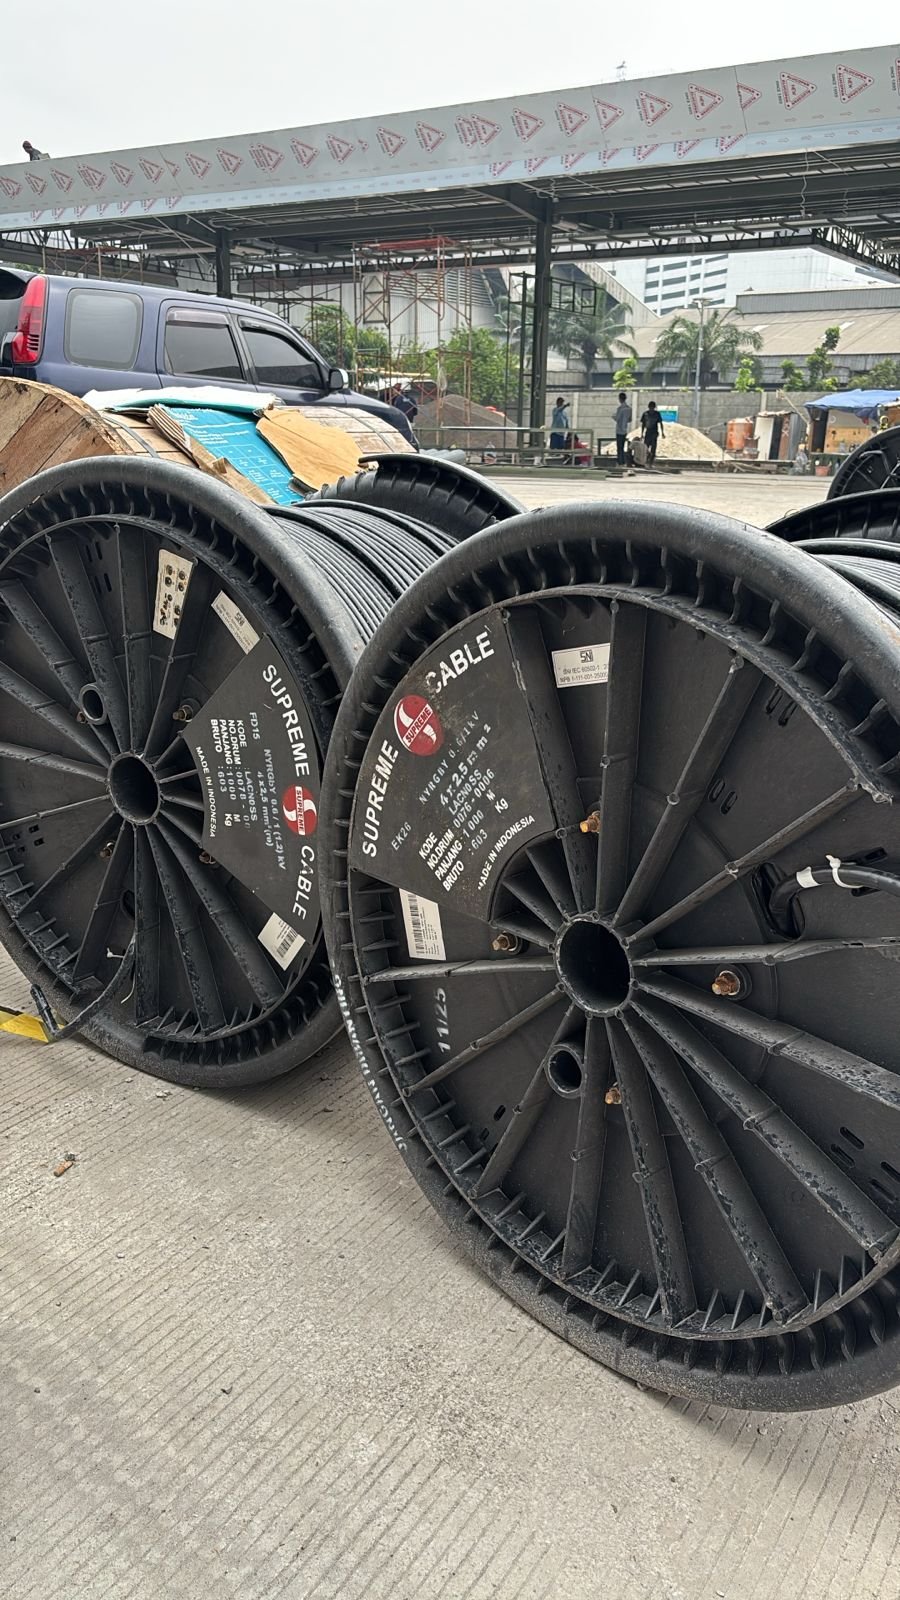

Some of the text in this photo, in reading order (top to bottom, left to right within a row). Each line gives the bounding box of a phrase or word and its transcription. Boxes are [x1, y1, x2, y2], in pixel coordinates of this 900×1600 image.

[228, 719, 242, 765] NO.DRUM
[236, 720, 247, 748] KODE
[249, 712, 260, 740] FD15
[362, 631, 495, 857] SUPREME SUPREME CABLE
[196, 746, 217, 837] MADE IN INDONESIA
[210, 719, 223, 753] BRUTO
[217, 771, 227, 792] 603
[224, 813, 232, 827] Kg
[219, 719, 233, 765] PANJANG
[226, 771, 237, 800] 1000
[233, 813, 241, 823] M
[263, 664, 316, 920] SUPREME SUPREME CABLE
[391, 822, 412, 851] EK26
[418, 832, 438, 859] KODE
[427, 828, 455, 870] NO.DRUM
[453, 801, 472, 828] 0076
[474, 768, 495, 798] 0006
[434, 840, 463, 881] PANJANG
[486, 789, 496, 801] M
[442, 860, 464, 891] BRUTO
[471, 829, 488, 849] 603
[494, 798, 509, 813] Kg
[488, 850, 498, 863] IN
[494, 815, 535, 852] INDONESIA
[277, 855, 287, 870] kV
[434, 987, 452, 1053] 11/25
